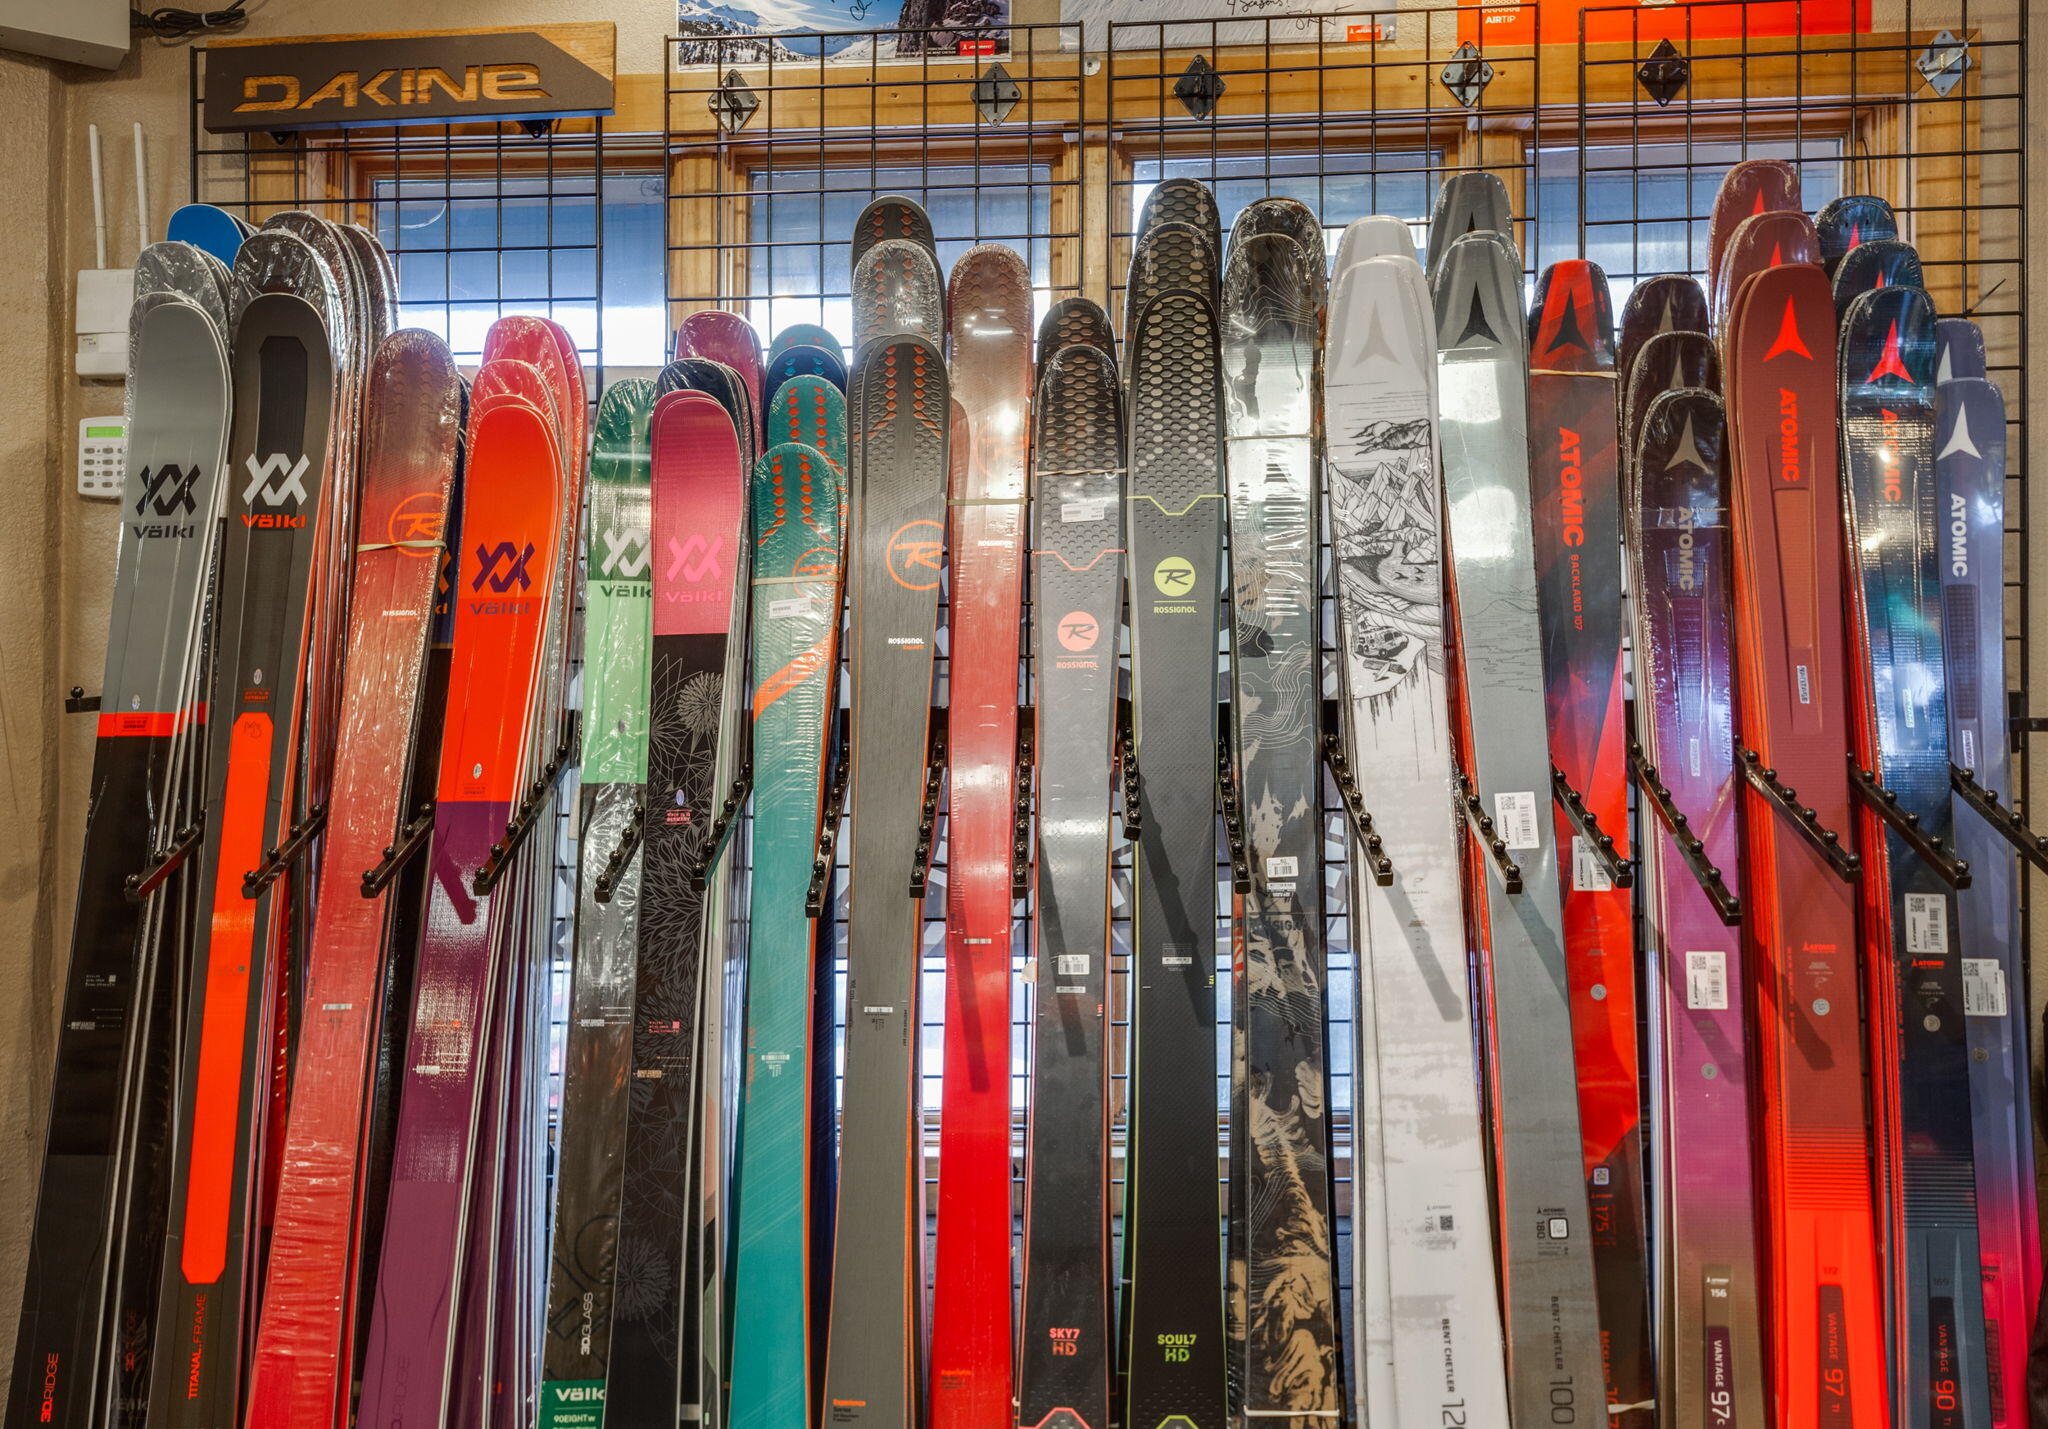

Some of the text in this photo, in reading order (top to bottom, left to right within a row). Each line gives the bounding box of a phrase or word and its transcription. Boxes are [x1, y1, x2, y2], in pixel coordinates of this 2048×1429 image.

[231, 62, 553, 113] DAKINE
[1779, 387, 1799, 482] ATOMIC
[1881, 408, 1901, 502] ATOMIC
[133, 525, 195, 539] Völkl
[242, 514, 307, 529] Völkl
[1559, 427, 1584, 632] ATOMIC BACKLAND 107
[1677, 506, 1694, 590] ATOMIC
[1951, 493, 1967, 578] ATOMIC
[601, 584, 652, 598] Völk
[665, 588, 723, 602] Völkl
[470, 601, 530, 616] Völkl
[1154, 605, 1197, 614] ROSSIGNOL
[888, 637, 925, 645] ROSSIGNOL
[1056, 660, 1099, 669] ROSSIGNOL
[1536, 1220, 1546, 1240] 180
[1595, 1206, 1609, 1232] 175
[1710, 1288, 1727, 1298] 156
[1049, 1327, 1080, 1339] SKY7
[1157, 1333, 1197, 1346] SOUL7
[1827, 1312, 1838, 1360] VANTAGE
[188, 1293, 207, 1400] TITANAL.FRAME
[1052, 1342, 1078, 1356] HD
[1165, 1348, 1190, 1363] HD
[1938, 1324, 1949, 1373] VANTAGE
[1441, 1318, 1466, 1429] BENT CHETLER 12
[1550, 1296, 1575, 1425] BENT CHETLER 100
[1714, 1339, 1725, 1388] VANTAGE
[40, 1353, 59, 1423] 3D.RIDGE
[556, 1387, 606, 1402] Völk
[1825, 1369, 1845, 1397] 97
[1936, 1380, 1956, 1410] 90
